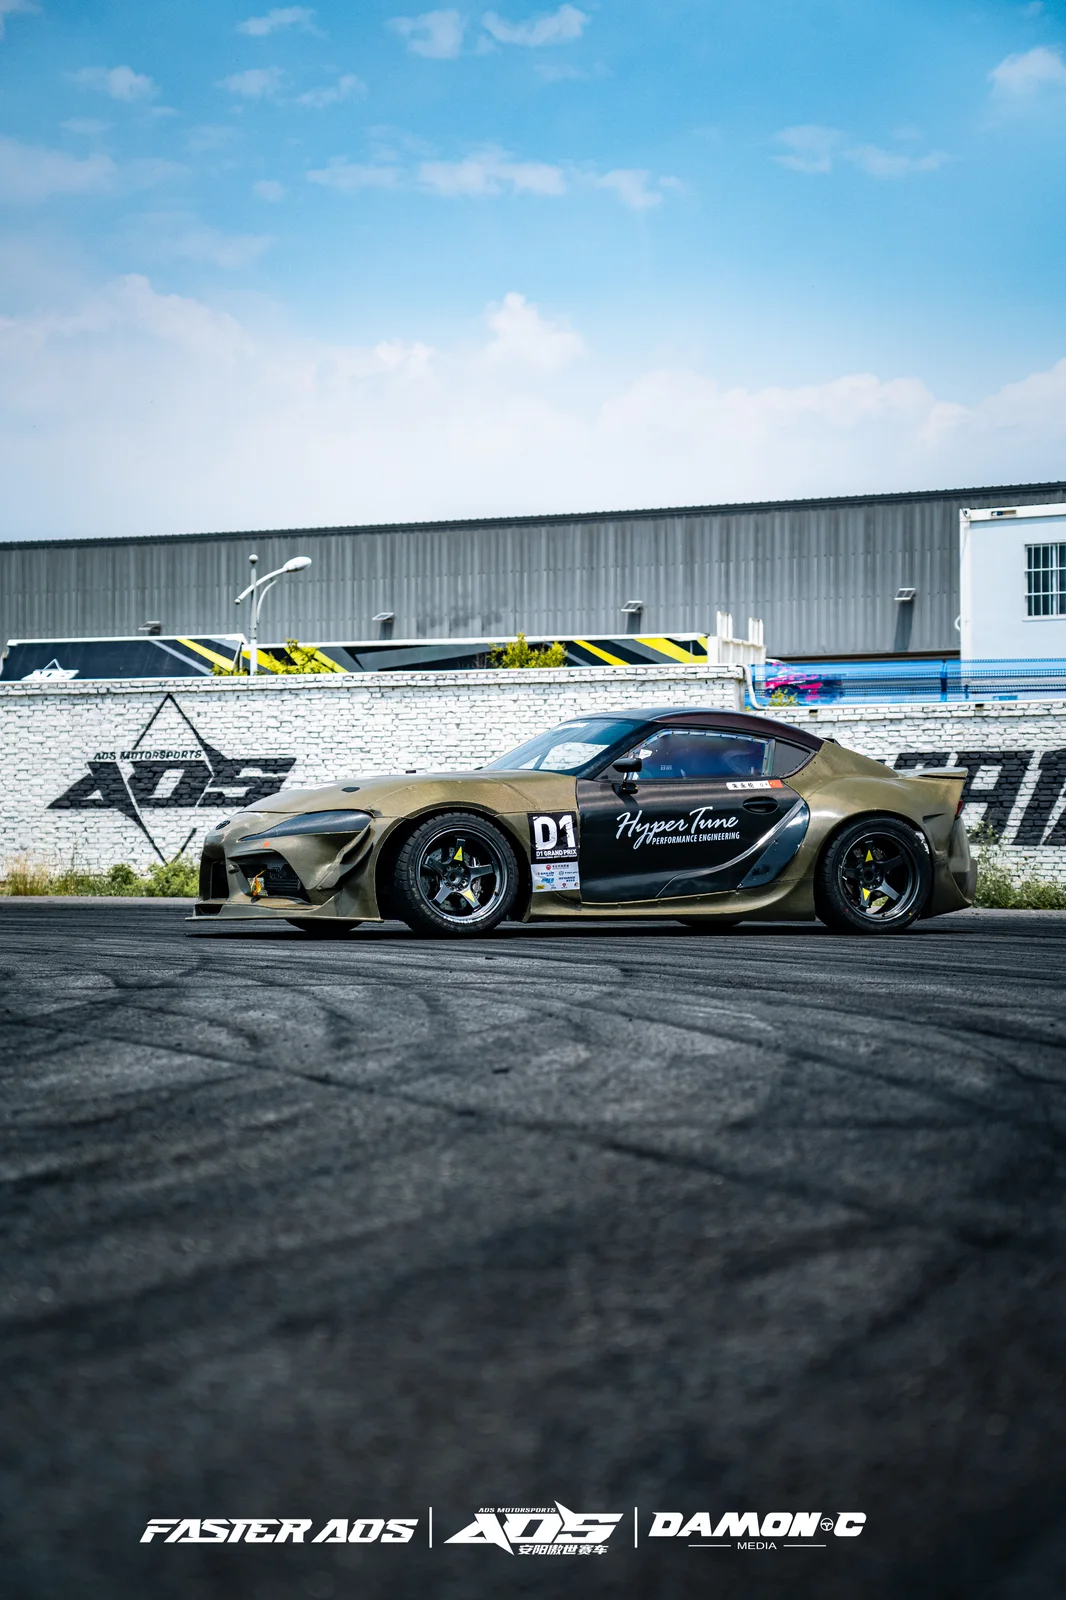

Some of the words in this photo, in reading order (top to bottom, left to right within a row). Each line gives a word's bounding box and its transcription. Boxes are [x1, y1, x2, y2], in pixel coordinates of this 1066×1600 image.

[120, 749, 202, 760] MOTORSPORTS
[533, 815, 576, 850] D1
[616, 810, 689, 850] Hyper
[689, 806, 739, 834] Tune
[652, 834, 697, 845] PERFORMANCE
[698, 831, 740, 842] ENGINEERING
[543, 849, 563, 857] GRAND
[563, 848, 577, 856] PRIX
